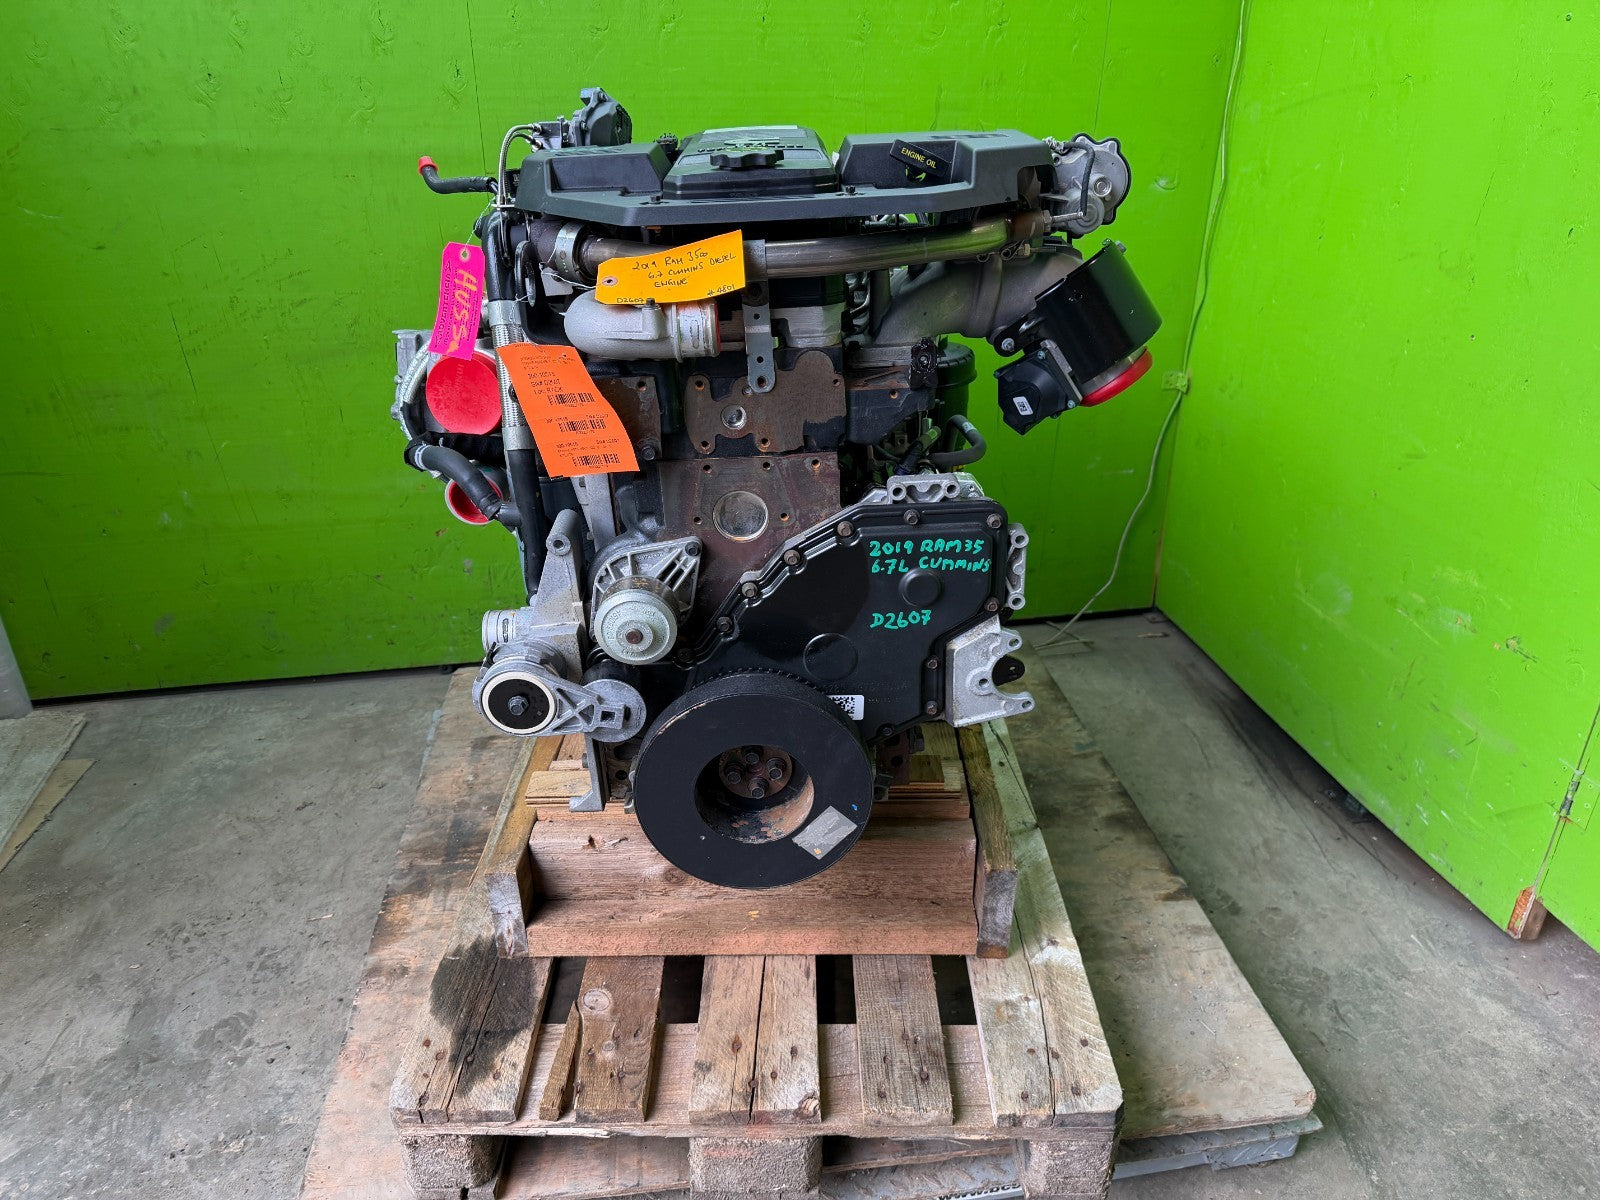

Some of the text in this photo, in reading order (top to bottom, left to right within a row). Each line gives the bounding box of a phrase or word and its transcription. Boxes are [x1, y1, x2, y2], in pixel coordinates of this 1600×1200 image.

[901, 147, 937, 169] ENGINE OIL
[665, 256, 684, 266] RAM
[668, 262, 704, 276] CUMMINS
[710, 252, 737, 266] DIESEL
[654, 278, 688, 288] ENGINE
[869, 540, 914, 557] 2019
[871, 556, 992, 575] 6.7L CUMMINS
[869, 609, 932, 630] D2607
